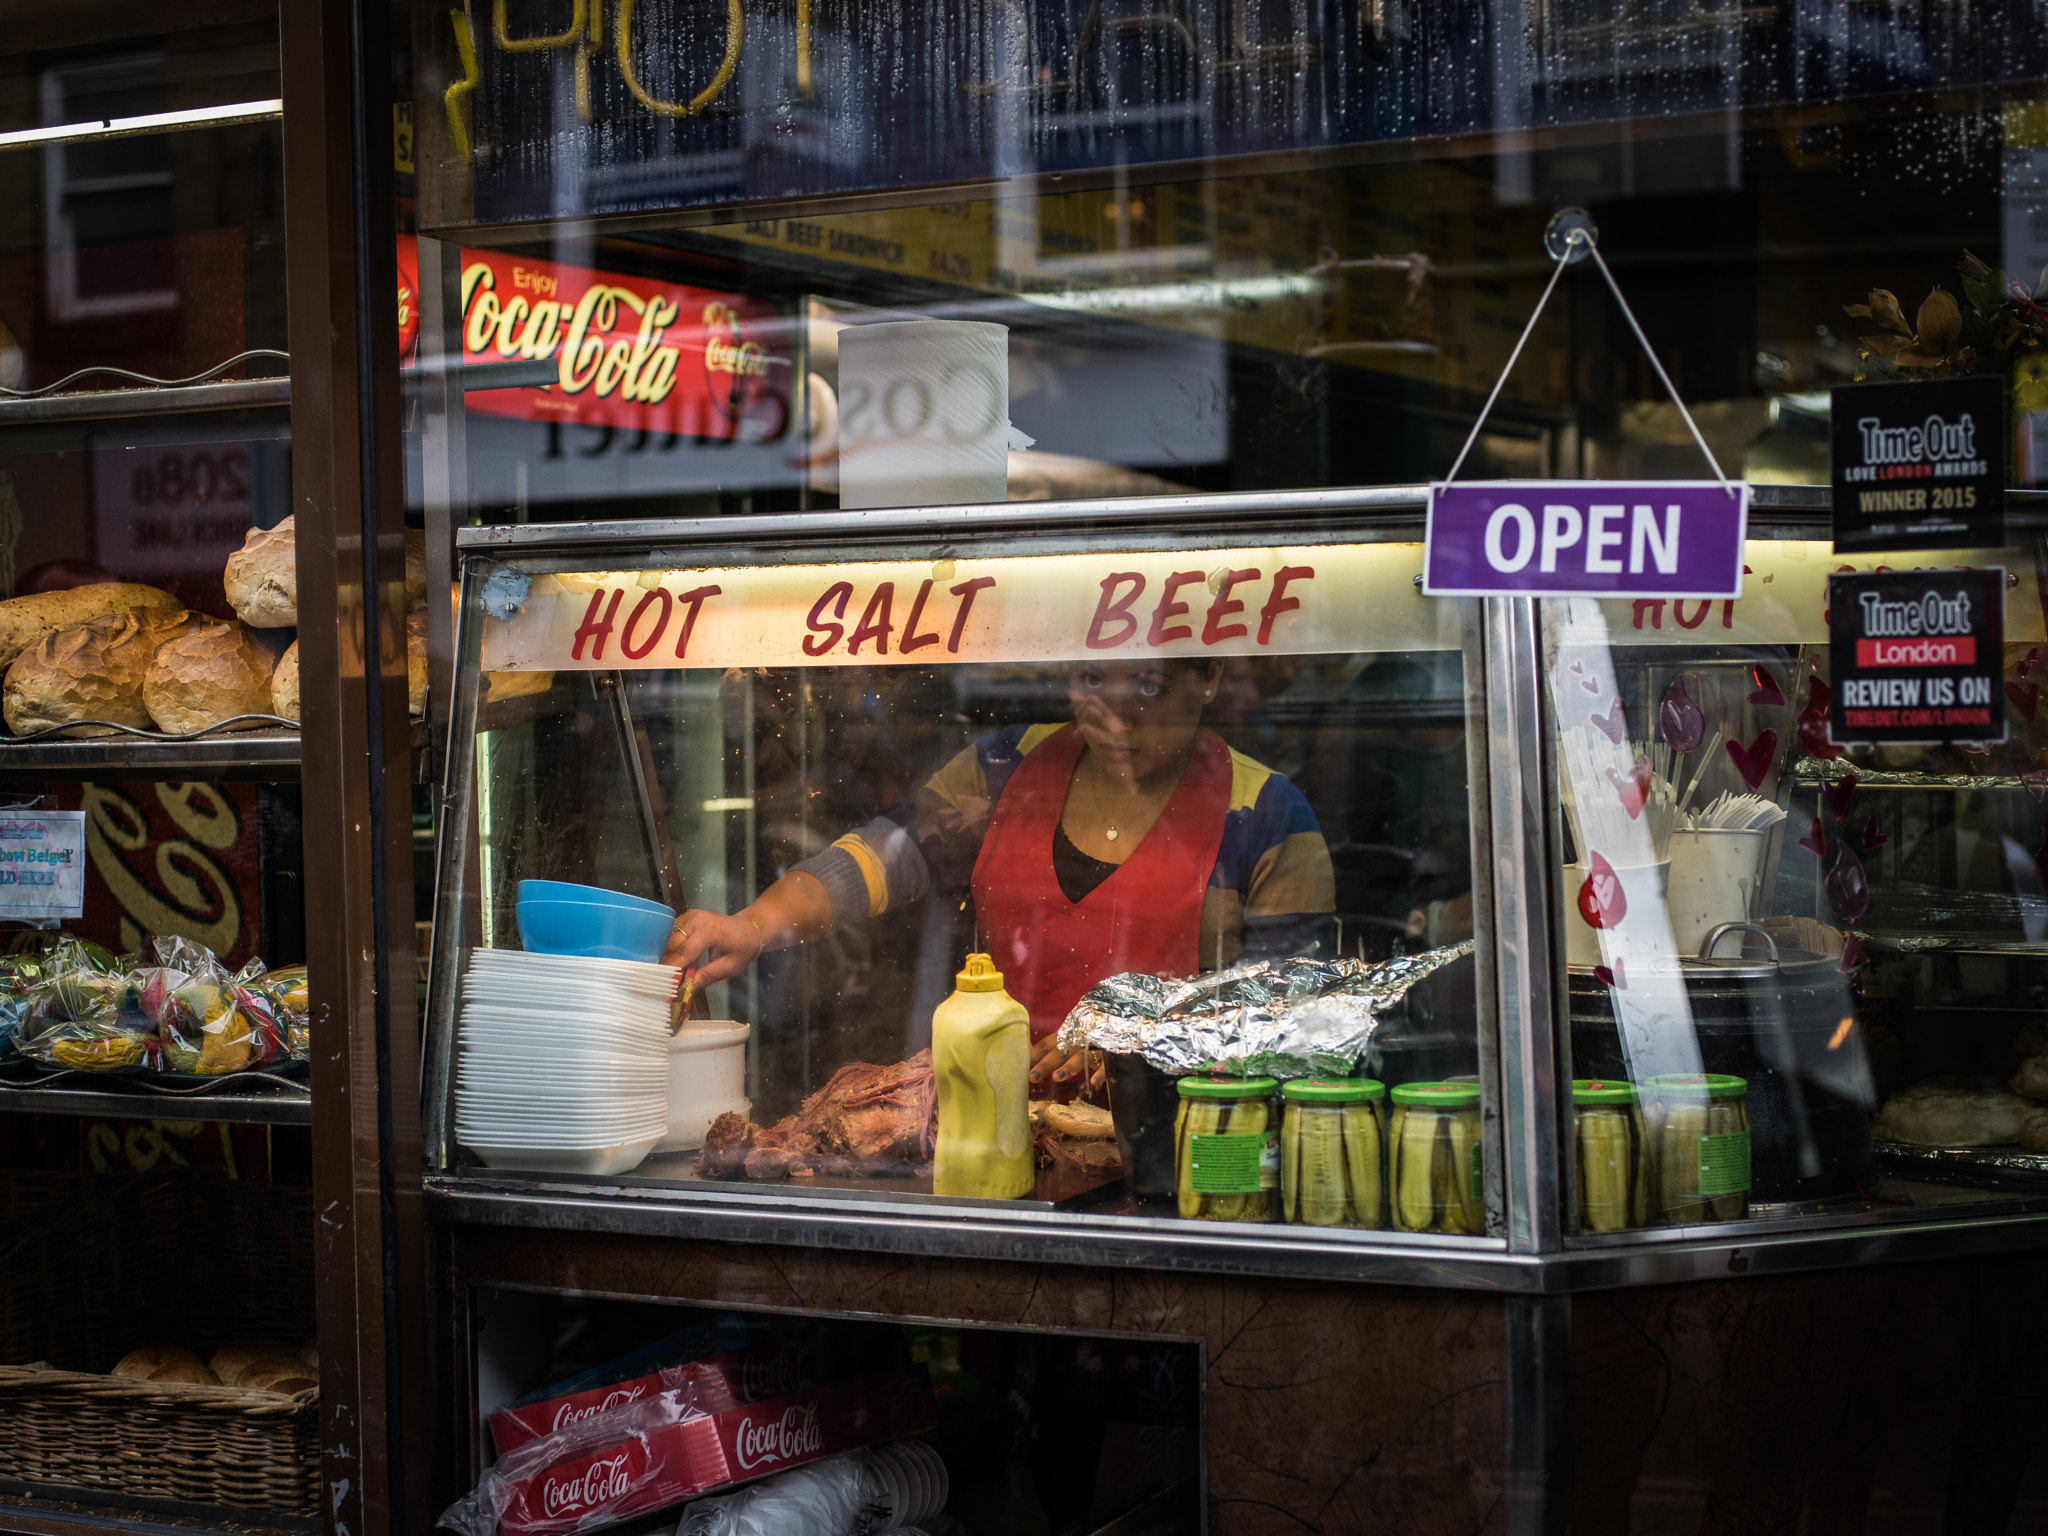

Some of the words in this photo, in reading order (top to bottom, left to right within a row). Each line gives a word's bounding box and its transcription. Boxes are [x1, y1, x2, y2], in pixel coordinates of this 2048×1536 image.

[786, 220, 823, 248] BEEF
[828, 228, 904, 264] SANDWICH
[512, 266, 558, 297] Enjoy
[1844, 466, 1878, 483] LOVE
[1879, 463, 1933, 481] LONDON
[1934, 460, 1989, 478] AWARDS
[1858, 489, 1928, 514] WINNER
[1931, 486, 1978, 510] 2015
[1484, 502, 1682, 576] OPEN
[571, 584, 722, 661] HOT
[802, 576, 996, 656] SALT
[1086, 566, 1316, 650] BEEF
[1875, 640, 1957, 664] London
[1842, 679, 1921, 708] REVIEW
[1926, 677, 1955, 706] US
[1959, 676, 1991, 705] ON
[1844, 708, 1991, 727] TIMEOUT.COM/LONDON
[18, 870, 55, 886] HERE
[737, 1400, 824, 1470] Coca-Cola
[543, 1452, 633, 1519] Coca-Cola
